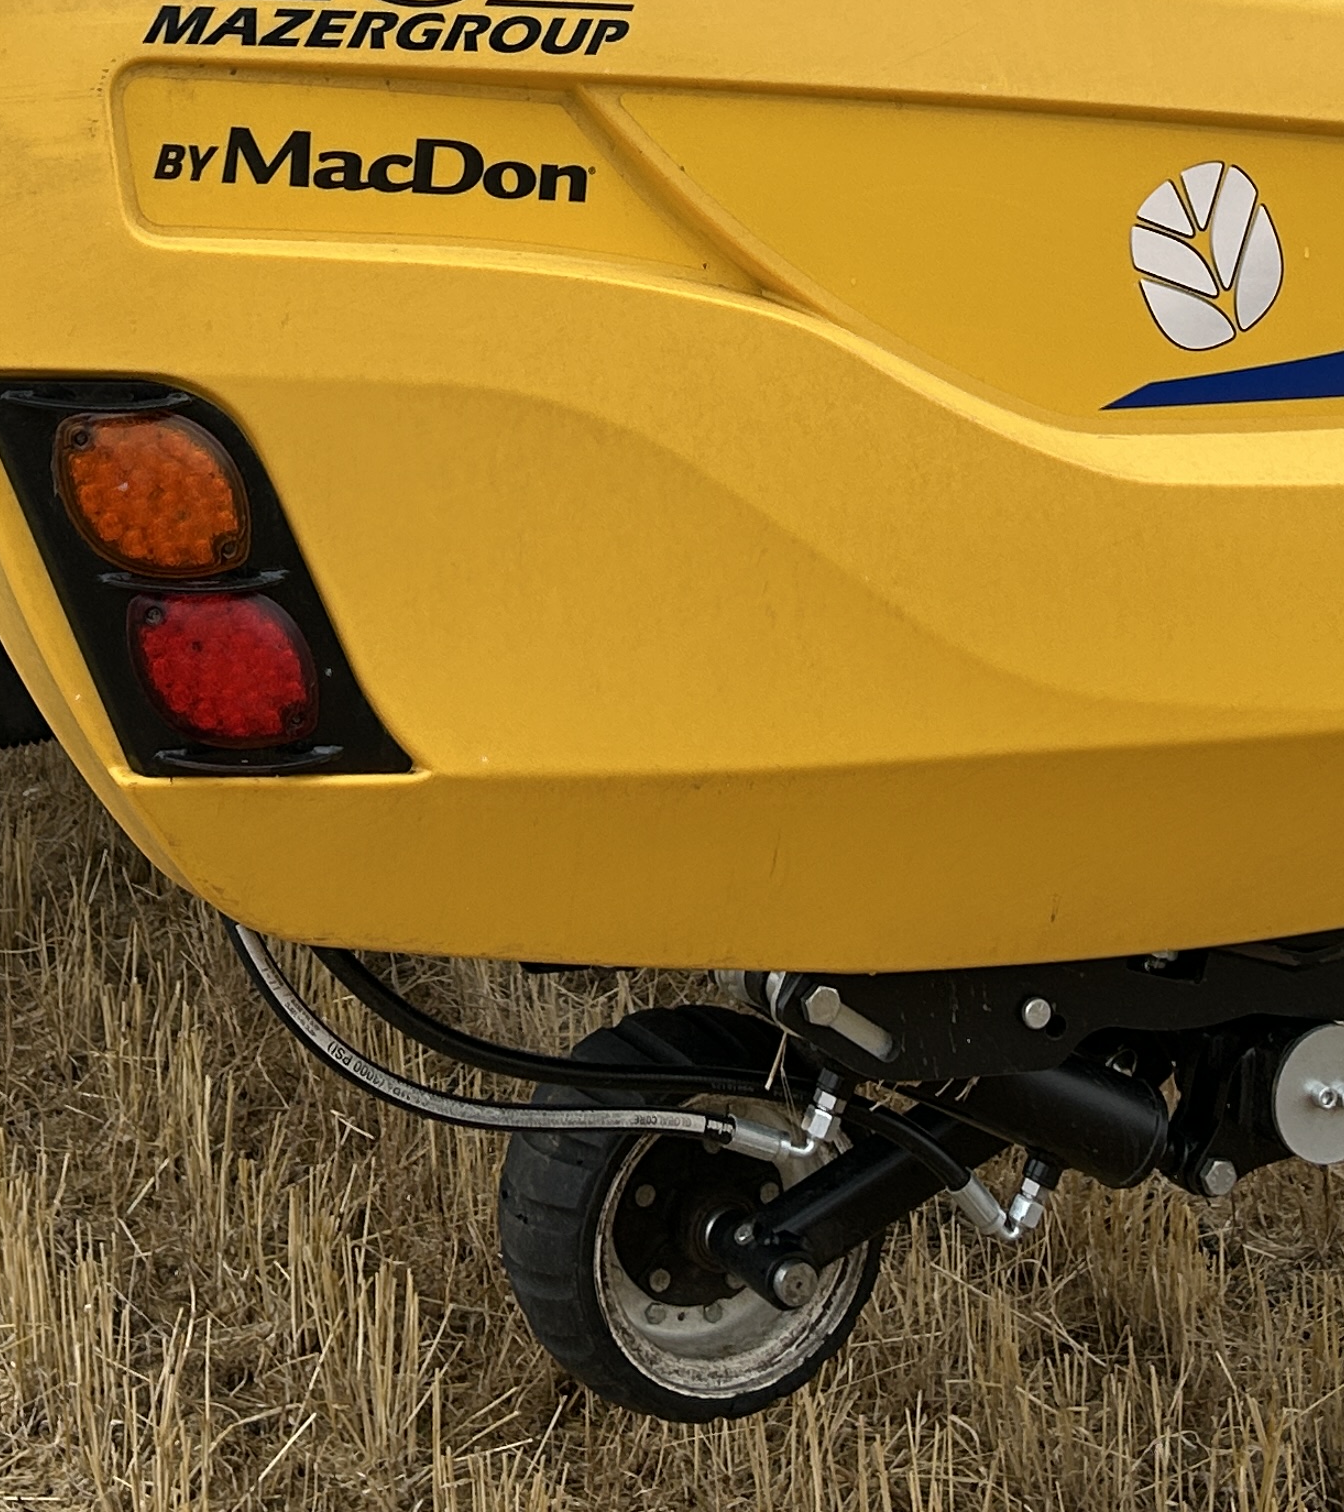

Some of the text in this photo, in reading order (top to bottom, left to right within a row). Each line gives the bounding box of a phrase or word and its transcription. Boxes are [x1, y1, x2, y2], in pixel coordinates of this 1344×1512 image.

[142, 4, 630, 56] MAZERGROUP
[153, 126, 588, 203] BY MacDon
